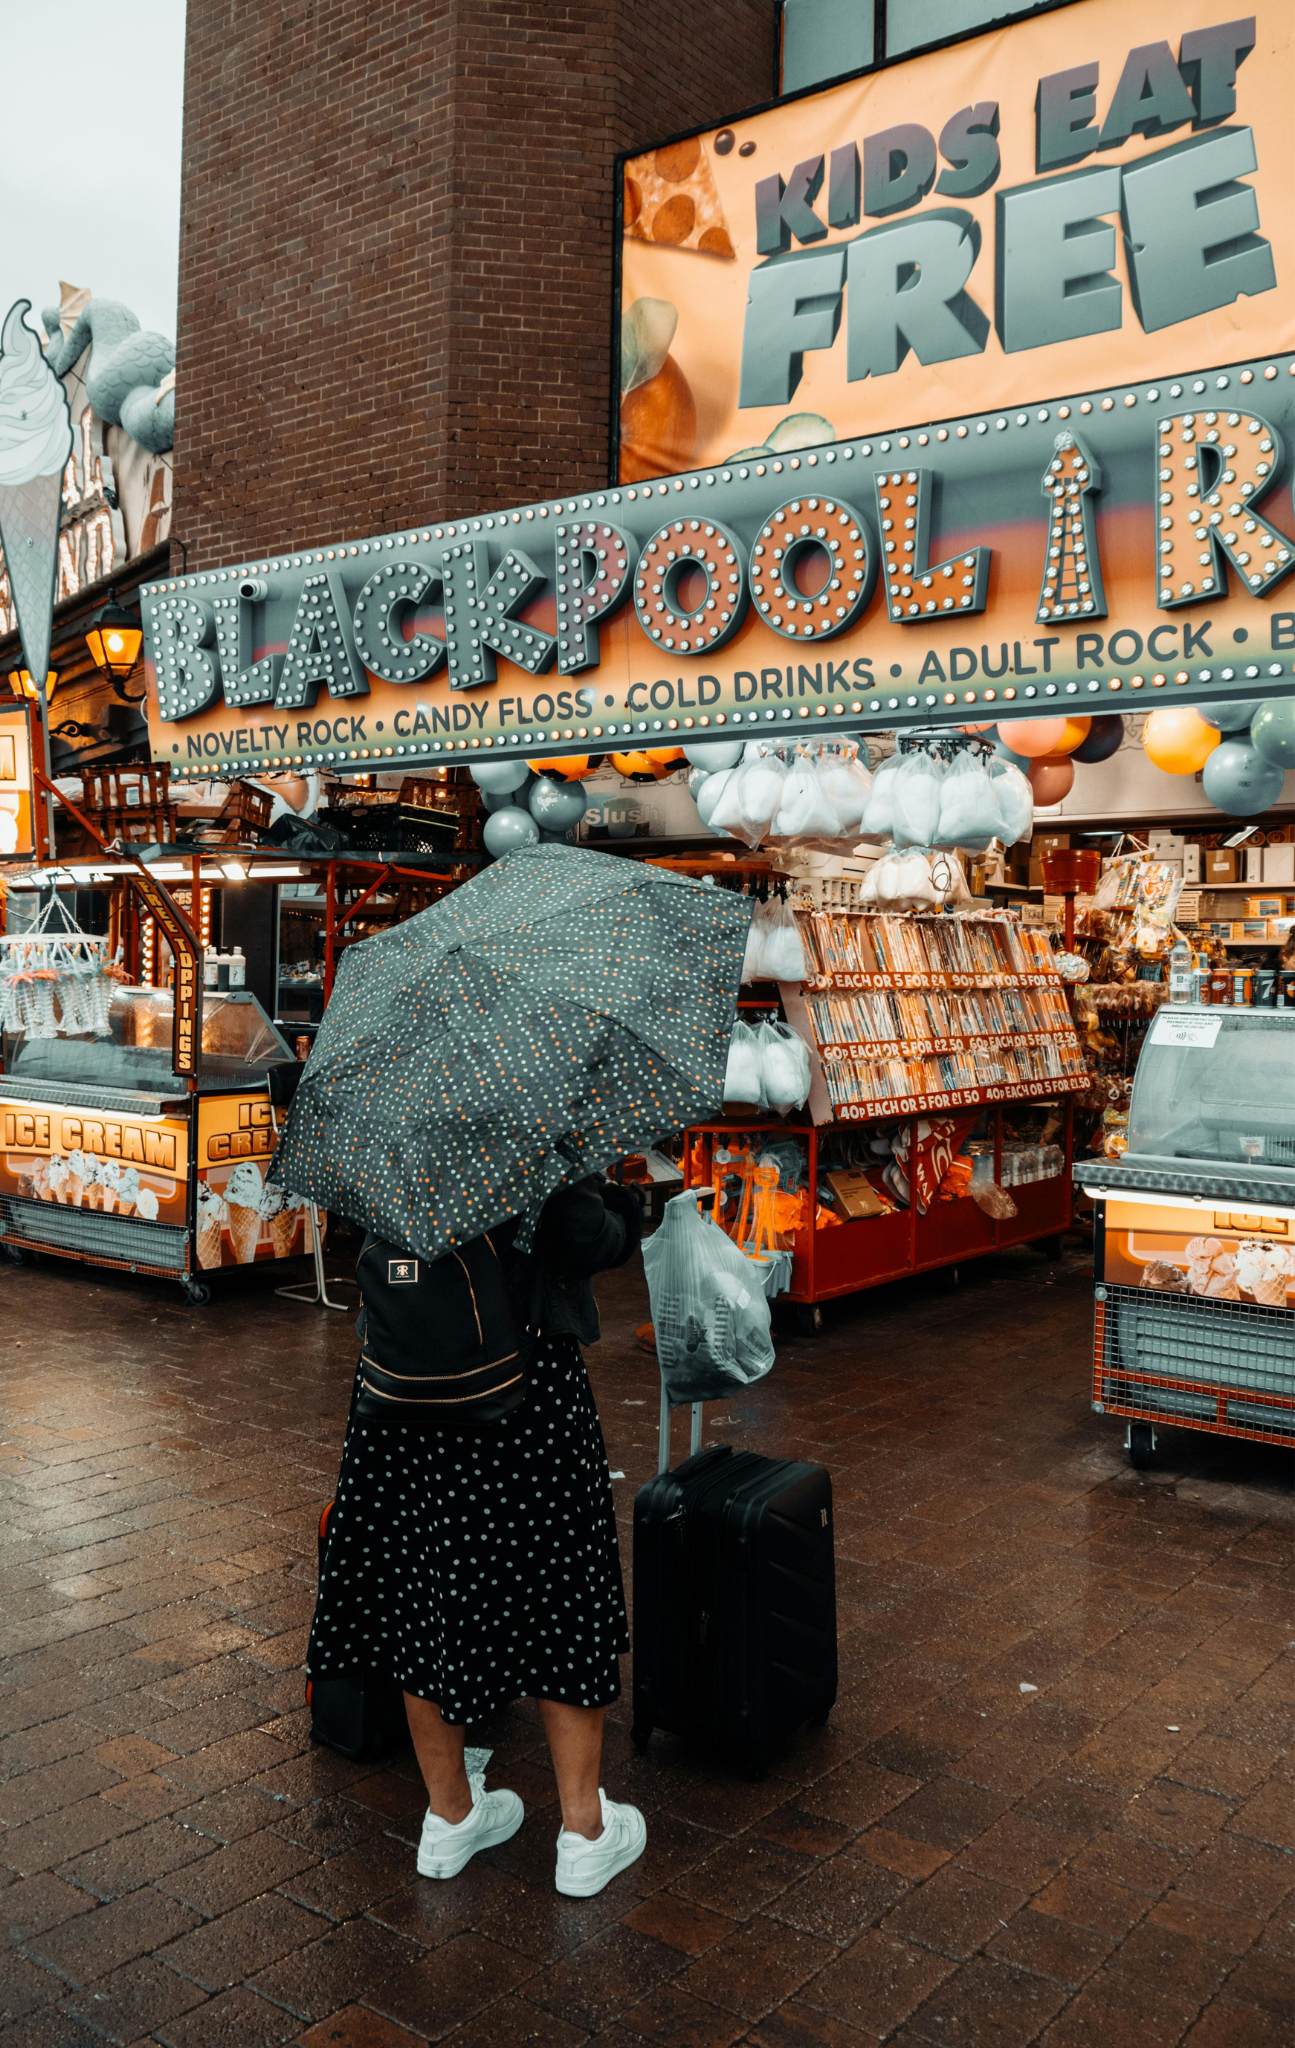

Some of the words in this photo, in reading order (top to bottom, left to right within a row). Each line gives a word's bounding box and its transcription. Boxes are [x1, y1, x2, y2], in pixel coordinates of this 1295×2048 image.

[755, 101, 1000, 256] KIDS
[1035, 16, 1256, 174] EAT
[737, 126, 1277, 408] FREE
[149, 467, 991, 722] BLACKPOOL
[187, 724, 289, 759] NOVELTY
[299, 716, 367, 747] ROCK
[393, 700, 488, 738] CANDY
[499, 689, 593, 727] FLOSS
[628, 673, 721, 713] COLD
[734, 657, 875, 702] DRINKS
[918, 637, 1060, 684] ADULT
[1076, 620, 1213, 669] ROCK
[585, 804, 665, 825] Slush
[137, 881, 179, 933] FREE
[173, 937, 193, 1070] TOPPINGS
[807, 974, 833, 988] 90p
[834, 974, 872, 988] EACH
[873, 974, 893, 988] OR
[893, 974, 903, 987] 5
[904, 974, 930, 987] FOR
[931, 974, 946, 987] £4
[951, 974, 974, 988] 90p
[974, 974, 1004, 987] EACH
[1004, 974, 1019, 987] OR
[1020, 974, 1028, 986] 5
[1027, 974, 1047, 986] FOR
[1047, 973, 1060, 986] £4
[824, 1046, 849, 1060] 60p
[849, 1043, 881, 1059] EACH
[883, 1042, 900, 1057] OR
[900, 1041, 910, 1054] 5
[910, 1040, 933, 1055] FOR
[934, 1038, 964, 1052] £2.50
[969, 1037, 988, 1050] 60p
[989, 1035, 1013, 1049] EACH
[1014, 1034, 1028, 1048] OR
[1028, 1033, 1037, 1046] 5
[1036, 1033, 1052, 1045] FOR
[1053, 1031, 1077, 1044] £2.50
[986, 1087, 1005, 1100] 40p
[1005, 1083, 1030, 1098] EACH
[1029, 1082, 1044, 1096] OR
[1044, 1080, 1052, 1093] 5
[1052, 1079, 1070, 1092] FOR
[1070, 1076, 1091, 1089] £1.50
[840, 1105, 865, 1119] 40p
[866, 1101, 899, 1117] EACH
[900, 1098, 918, 1113] OR
[918, 1096, 927, 1110] 5
[927, 1092, 951, 1109] FOR
[951, 1090, 980, 1105] £1.50
[5, 1113, 50, 1149] ICE
[61, 1117, 177, 1170] CREAM
